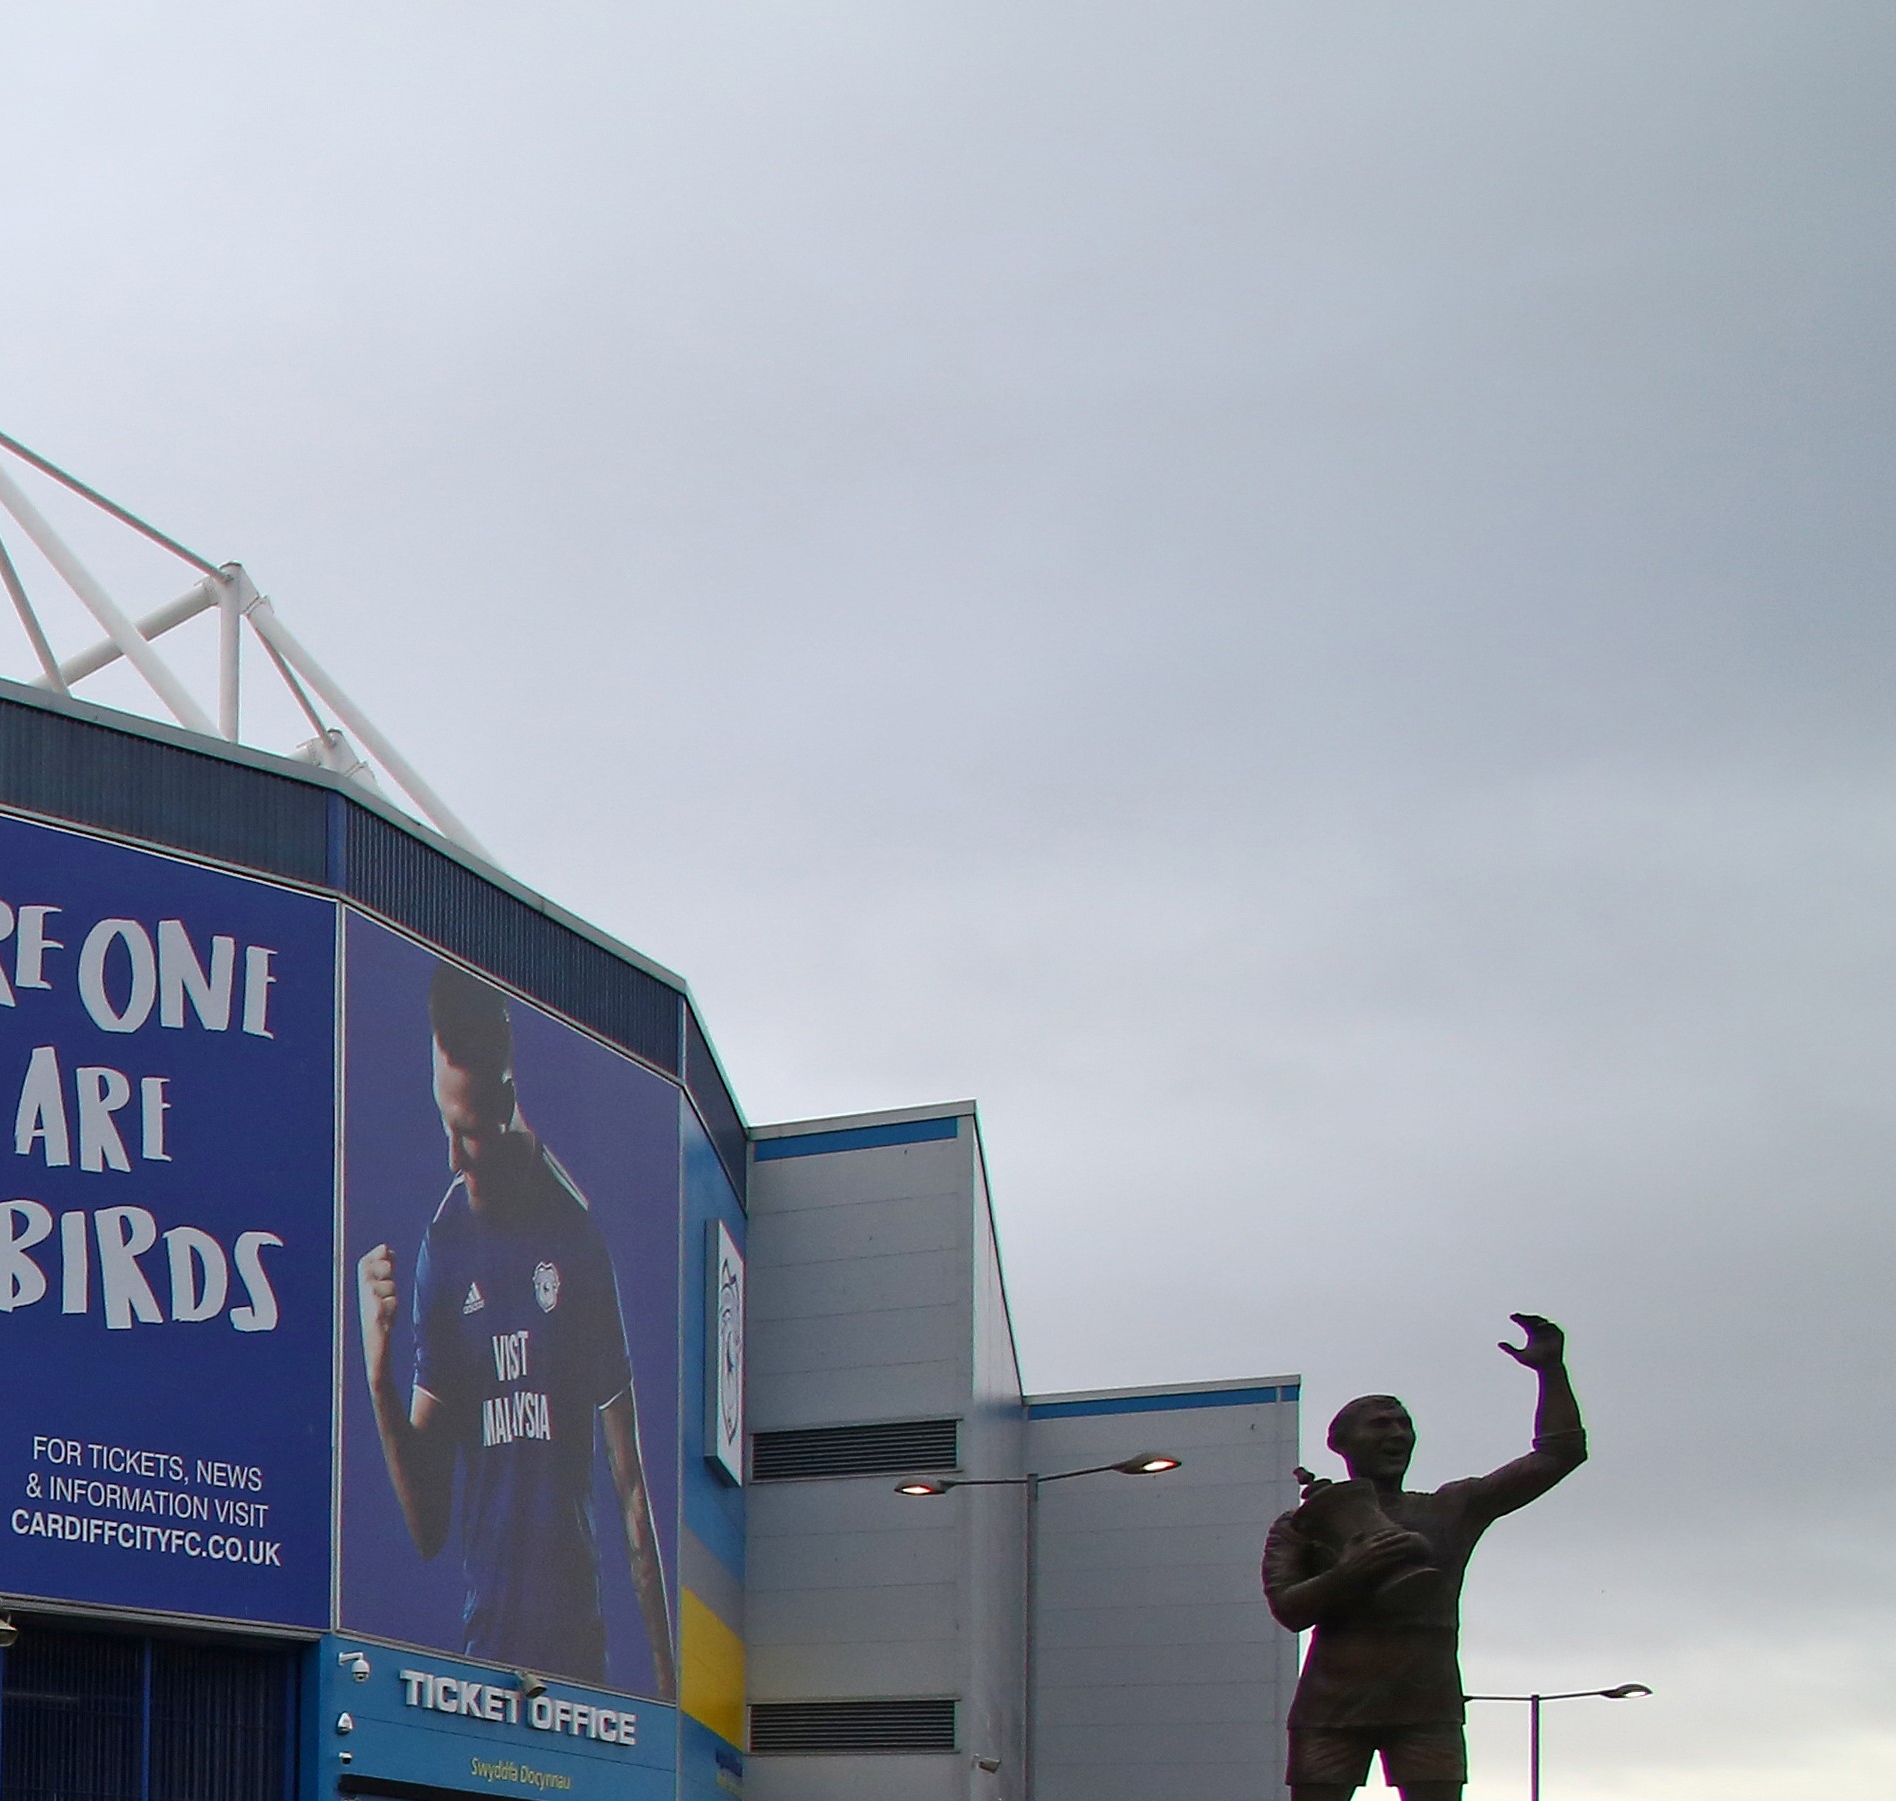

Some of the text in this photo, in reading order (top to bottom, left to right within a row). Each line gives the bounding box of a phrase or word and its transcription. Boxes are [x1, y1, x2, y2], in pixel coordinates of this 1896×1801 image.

[78, 918, 278, 1039] ONE
[15, 1046, 172, 1172] ARE
[33, 1436, 263, 1492] FOR TICKETS, NEWS
[26, 1473, 269, 1528] & INFORMATION VISIT
[11, 1508, 281, 1566] CARDIFFCITYFC.CO.UK
[399, 1669, 638, 1746] TICKET OFFICE
